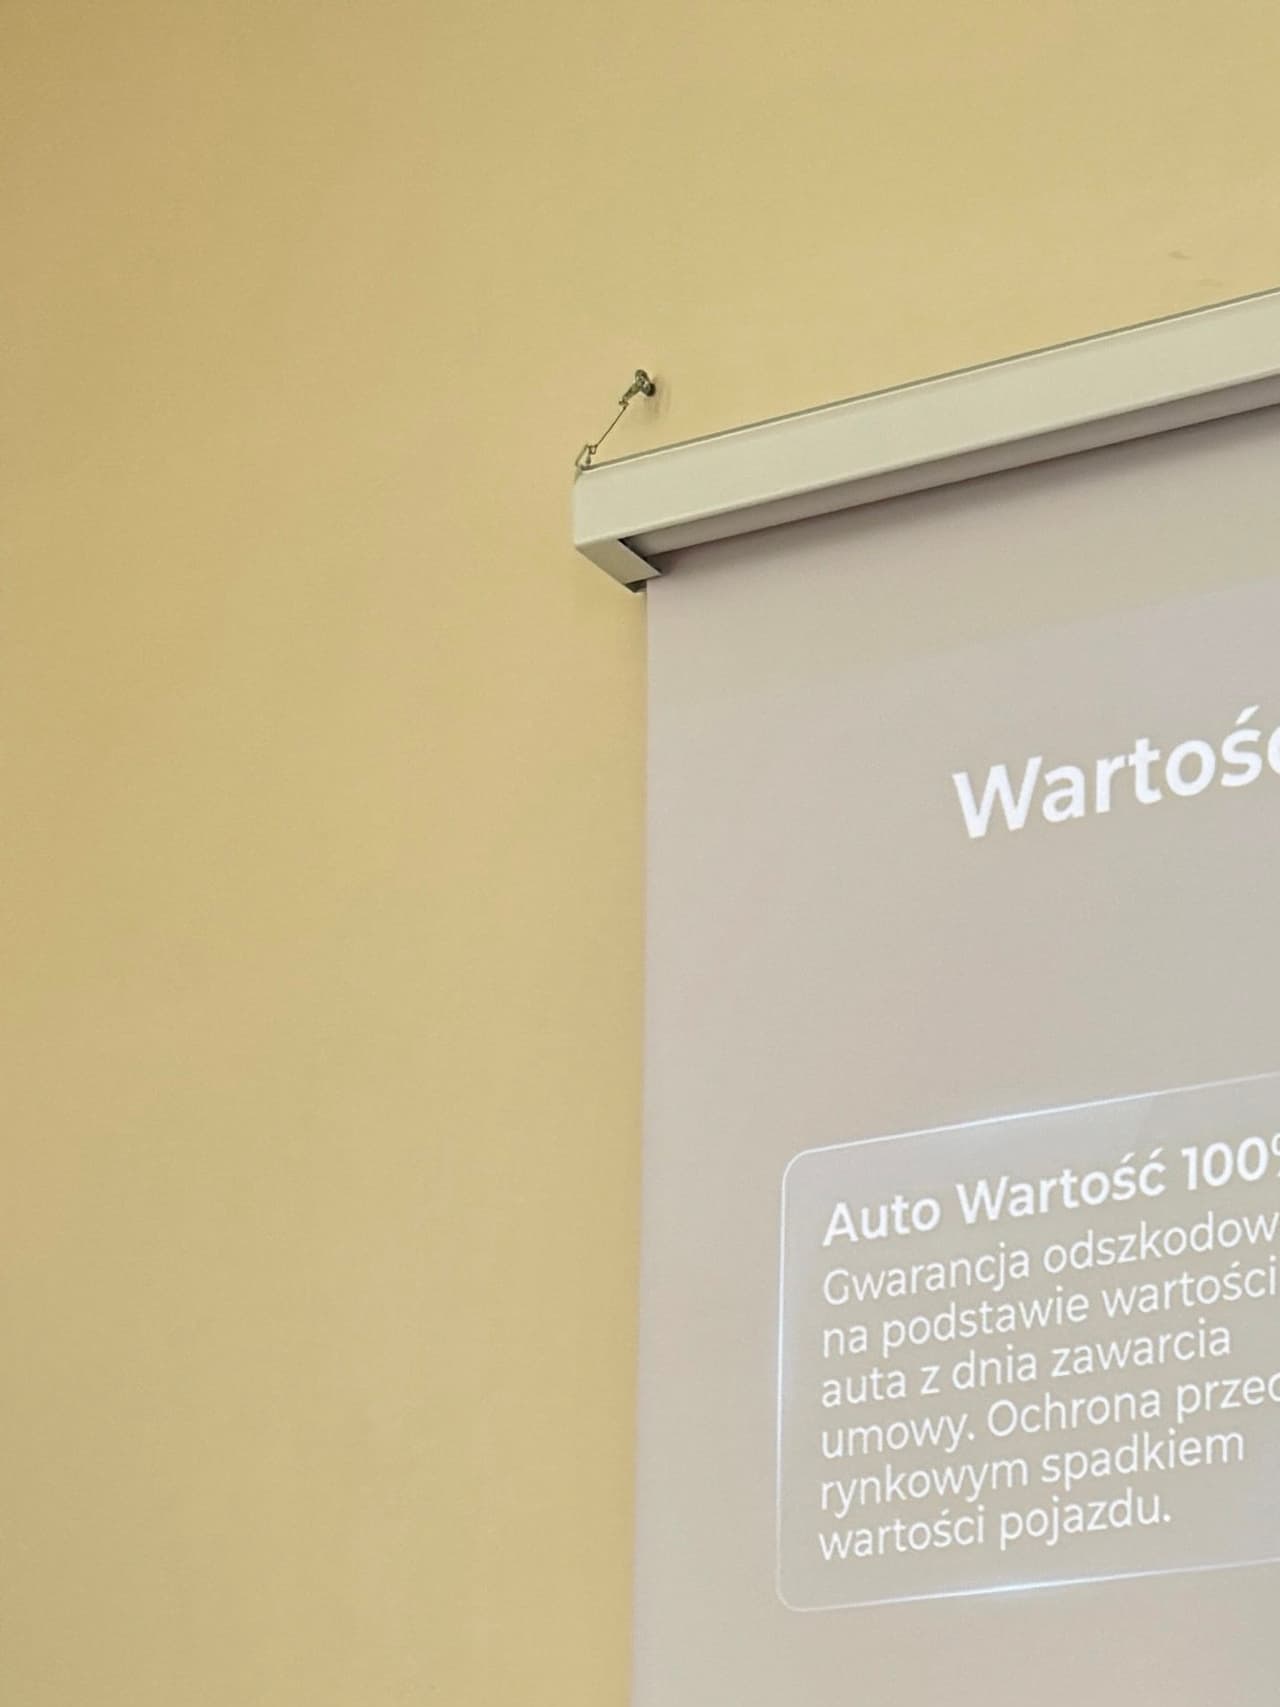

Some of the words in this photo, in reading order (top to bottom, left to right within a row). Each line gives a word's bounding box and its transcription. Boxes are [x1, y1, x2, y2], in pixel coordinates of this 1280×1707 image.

[823, 1196, 940, 1245] Auto
[956, 1148, 1165, 1223] Wartość
[824, 1242, 1029, 1304] Gwarancja
[824, 1326, 867, 1357] na
[883, 1286, 1089, 1358] podstawie
[1102, 1255, 1276, 1317] wartości
[822, 1367, 905, 1407] auta
[921, 1366, 940, 1394] z
[952, 1344, 1036, 1389] dnia
[1051, 1318, 1229, 1376] zawarcia
[823, 1414, 974, 1458] umowy.
[988, 1390, 1160, 1436] Ochrona
[822, 1459, 1027, 1518] rynkowym
[1042, 1428, 1243, 1491] spadkiem
[819, 1505, 984, 1560] wartości
[1001, 1487, 1170, 1550] pojazdu.
